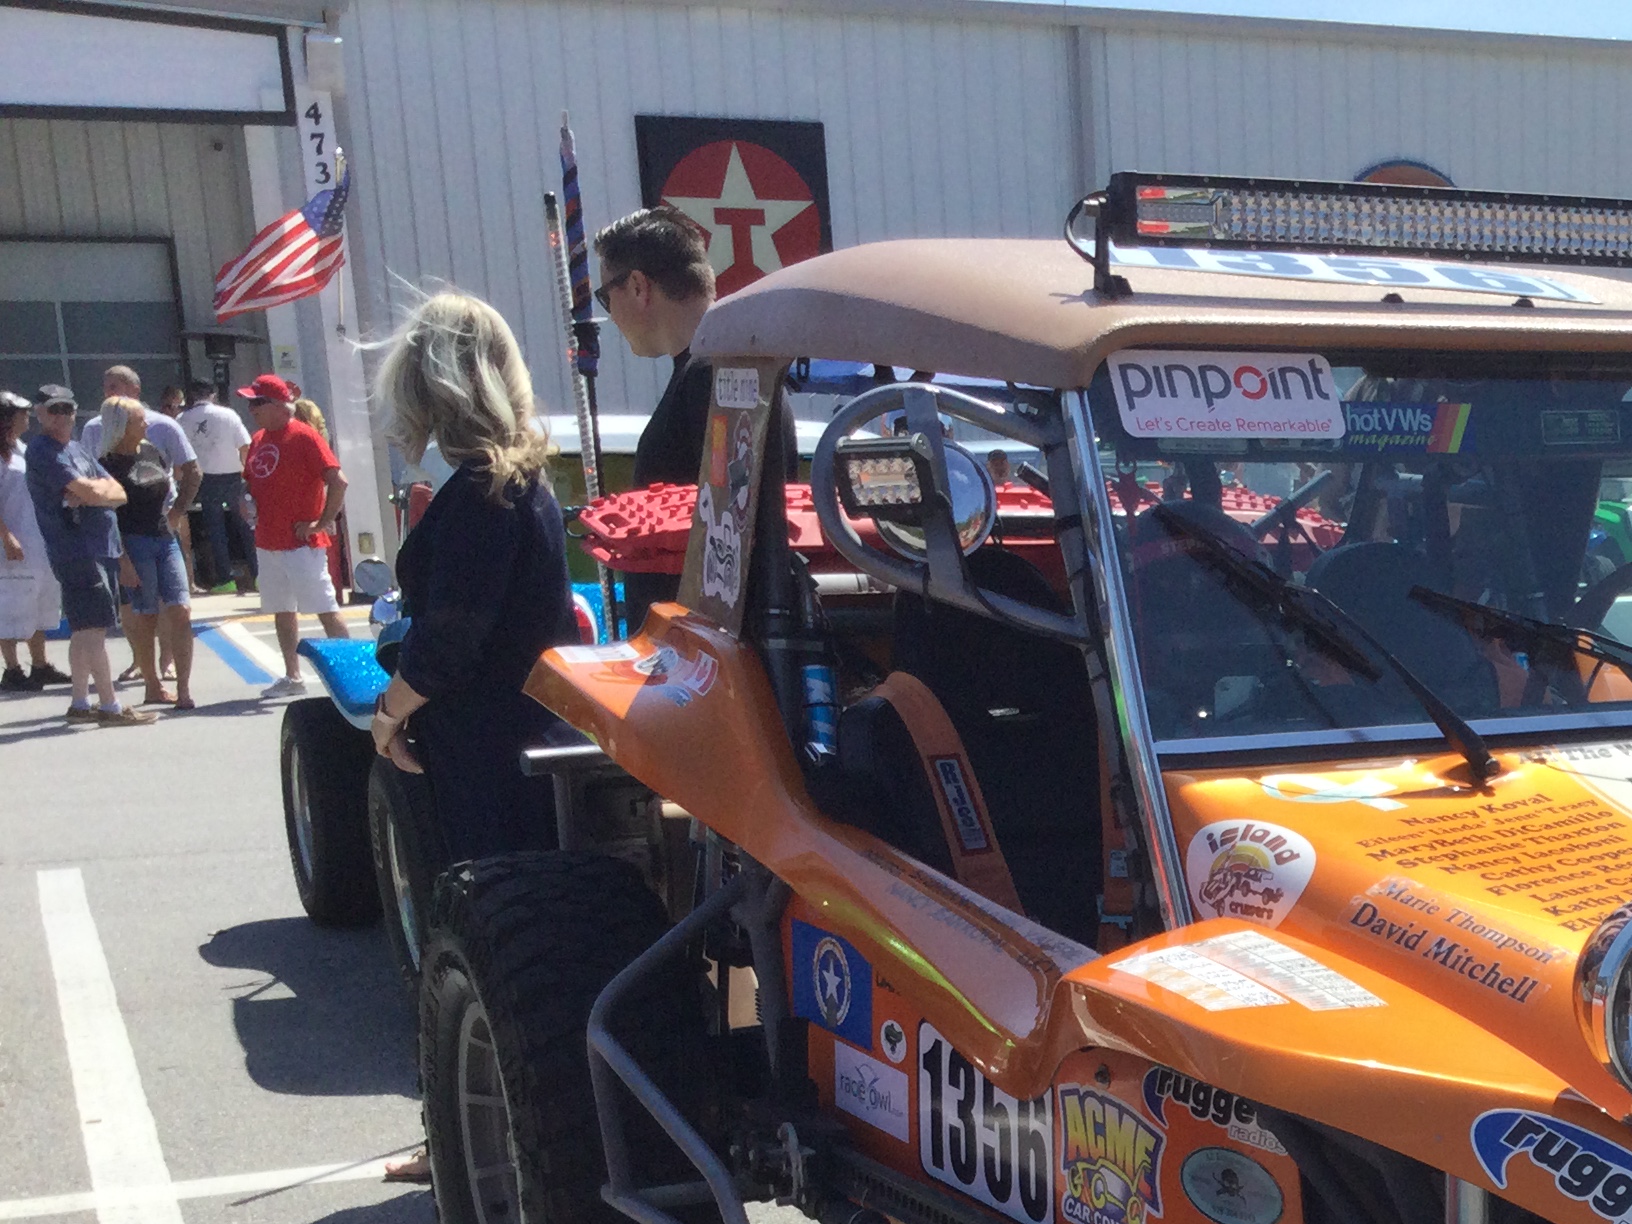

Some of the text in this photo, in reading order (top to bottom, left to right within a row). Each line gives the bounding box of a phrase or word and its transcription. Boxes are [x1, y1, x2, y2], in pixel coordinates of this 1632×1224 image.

[1118, 358, 1331, 413] pinpoint
[1136, 417, 1173, 432] Let's
[1176, 417, 1231, 433] Create
[1564, 745, 1613, 761] The
[1397, 793, 1554, 828] Nancy Koval
[1542, 798, 1599, 816] Tracy
[1206, 823, 1301, 866] island
[1364, 810, 1615, 862] MaryBeth DiCamillo
[1395, 820, 1627, 870] Stephanie Thaxton
[1437, 852, 1523, 875] Nancy
[1479, 861, 1558, 881] Cathy
[1484, 868, 1594, 897] Florence
[1529, 882, 1608, 904] Laura
[1541, 893, 1622, 918] Kathy
[1382, 882, 1555, 965] Marie Thompson
[1350, 901, 1429, 951] David
[1422, 936, 1539, 1004] Mitchell
[922, 1038, 1049, 1223] 1356
[1064, 1094, 1158, 1183] ACME
[1064, 1197, 1092, 1224] CAR
